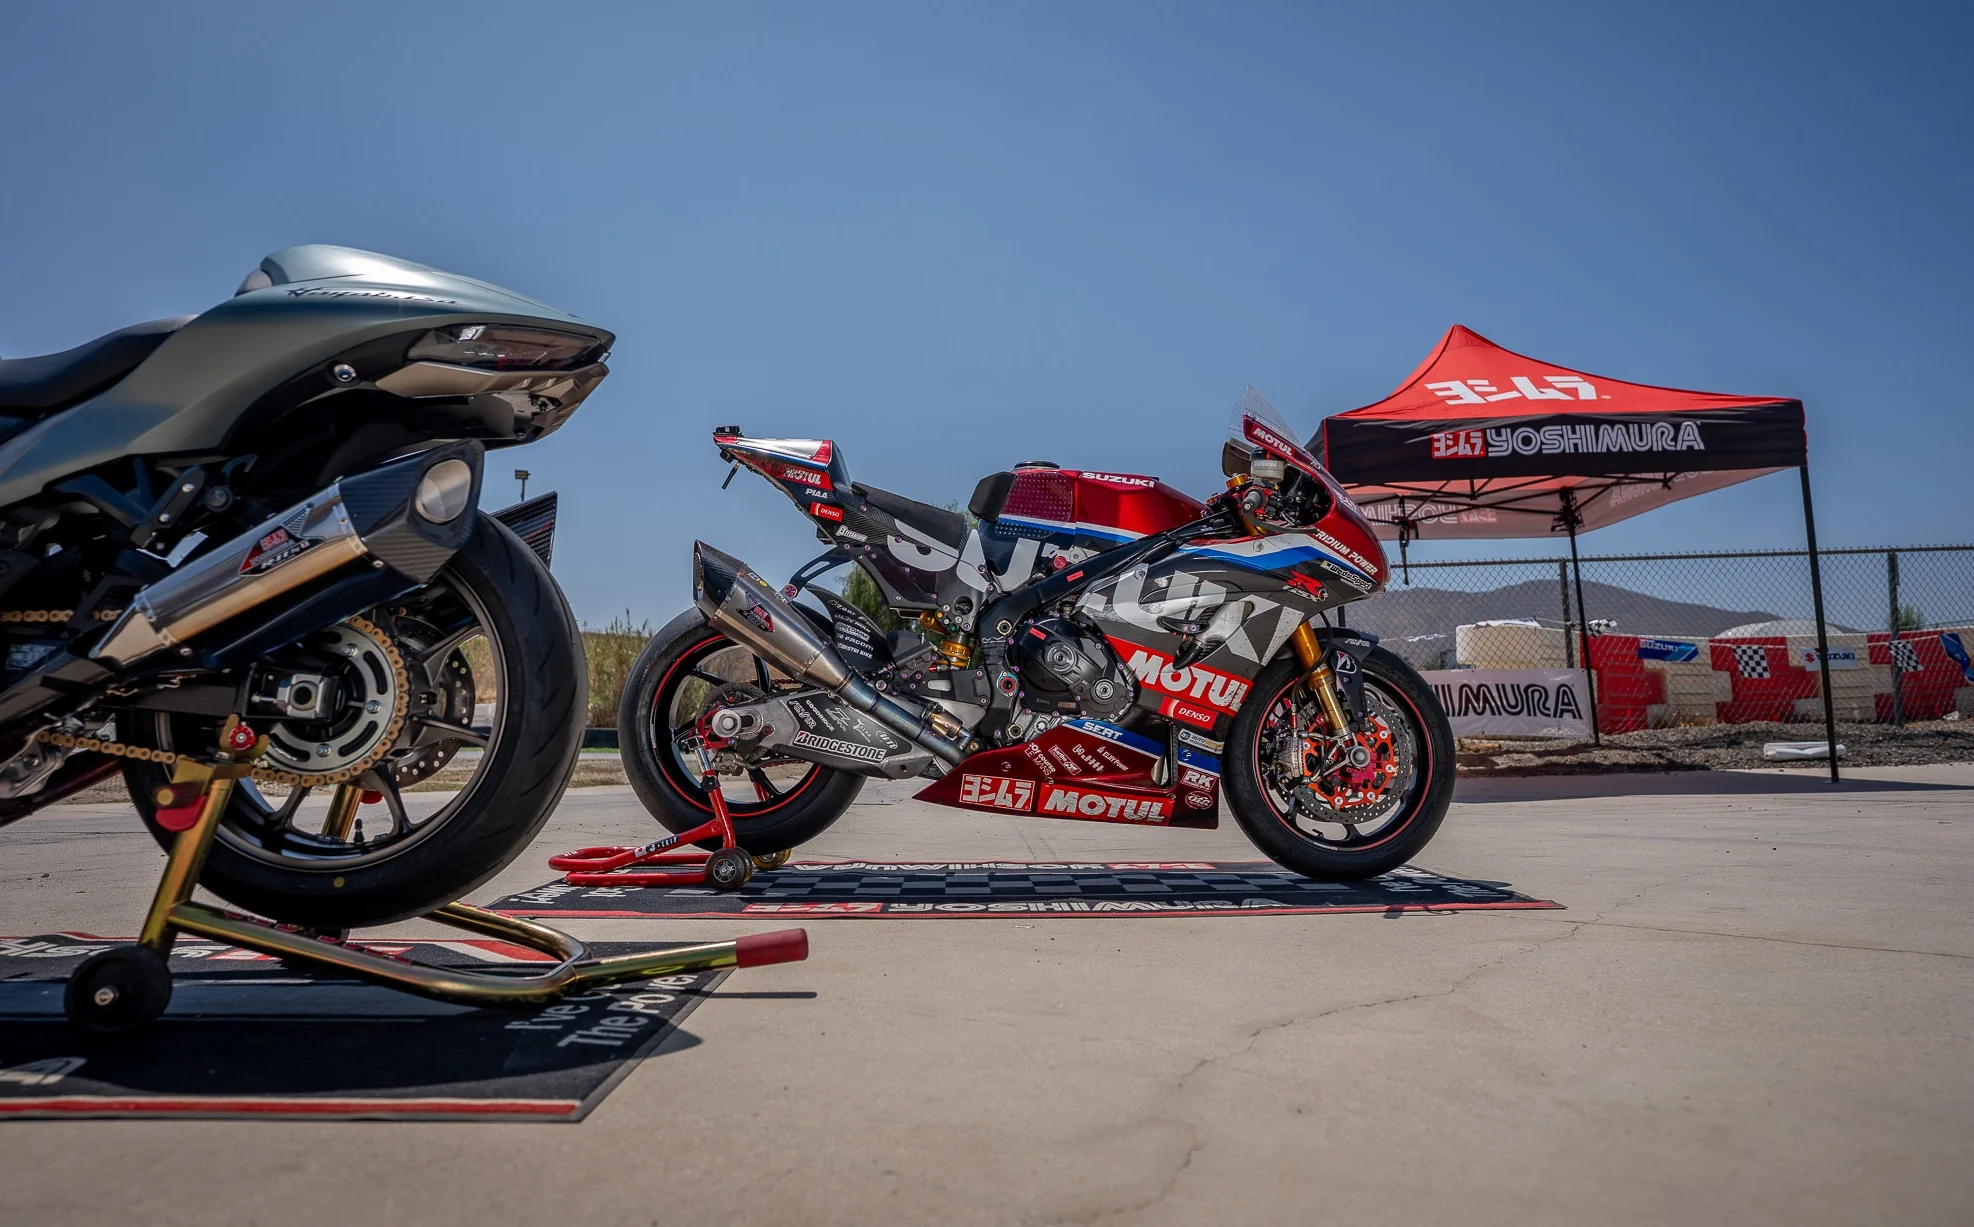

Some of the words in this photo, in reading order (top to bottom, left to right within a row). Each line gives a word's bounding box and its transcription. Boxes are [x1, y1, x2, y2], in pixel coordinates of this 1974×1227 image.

[1424, 375, 1599, 405] ヨシムラ
[1253, 427, 1293, 456] MOTUL
[1487, 421, 1706, 457] YOSHIMURA
[784, 468, 822, 486] MOTUL
[1080, 471, 1155, 488] SUZUKI
[805, 488, 829, 500] PIAA
[820, 507, 840, 518] DENSO
[1313, 528, 1351, 555] RIDIUM
[1348, 551, 1378, 576] POWER
[1126, 650, 1248, 712] MOTUL
[1178, 707, 1211, 723] DENSO
[1082, 721, 1123, 740] SERT
[797, 731, 886, 761] BRIDGESTONE
[1032, 757, 1053, 776] MANS
[1038, 753, 1057, 773] course
[1184, 769, 1214, 790] RK
[962, 775, 1031, 812] ヨシムラ
[1044, 789, 1165, 823] MOTUL
[888, 897, 1292, 912] YOSHIMURA
[504, 1003, 590, 1030] I've
[556, 1014, 650, 1048] The
